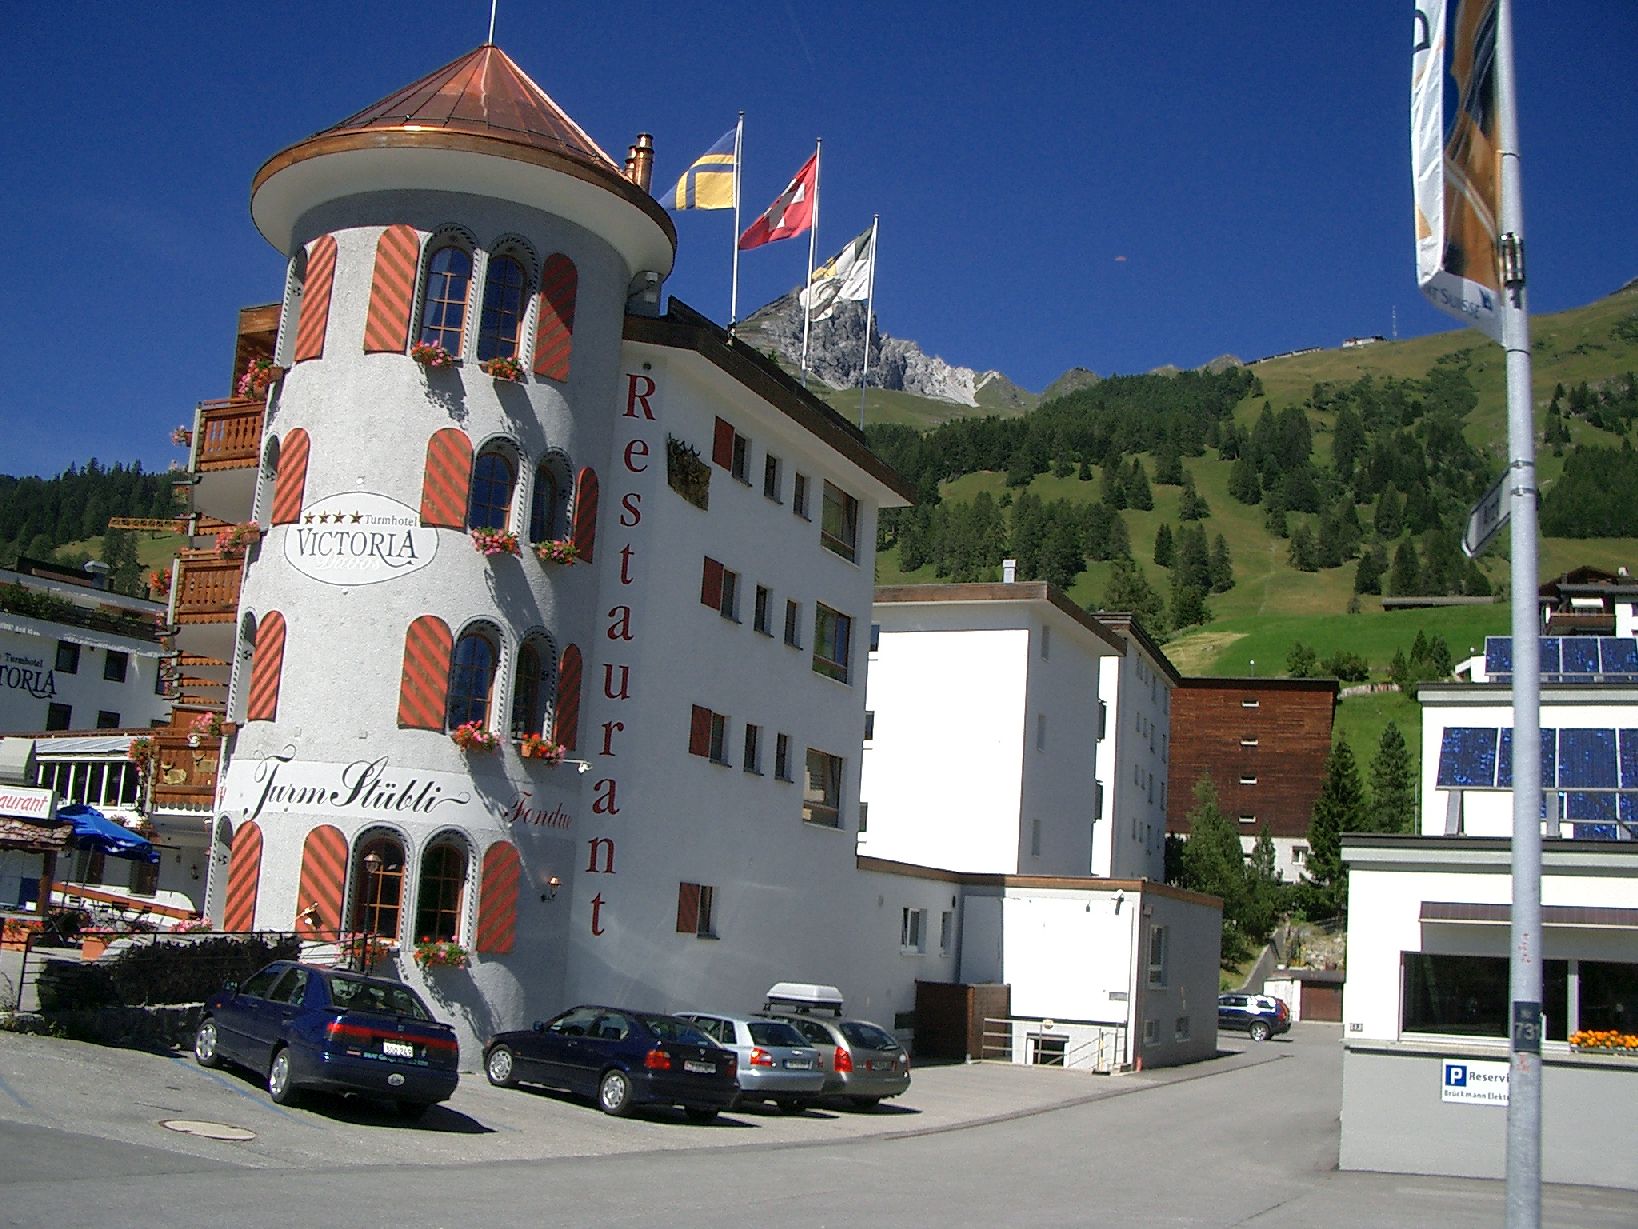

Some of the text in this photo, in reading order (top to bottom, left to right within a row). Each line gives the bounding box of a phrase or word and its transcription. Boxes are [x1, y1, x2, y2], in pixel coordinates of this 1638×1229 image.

[297, 528, 419, 568] VICTORIA
[365, 514, 418, 527] Turmhotel
[584, 373, 657, 937] Restaurant
[243, 744, 470, 820] Turm Stübli
